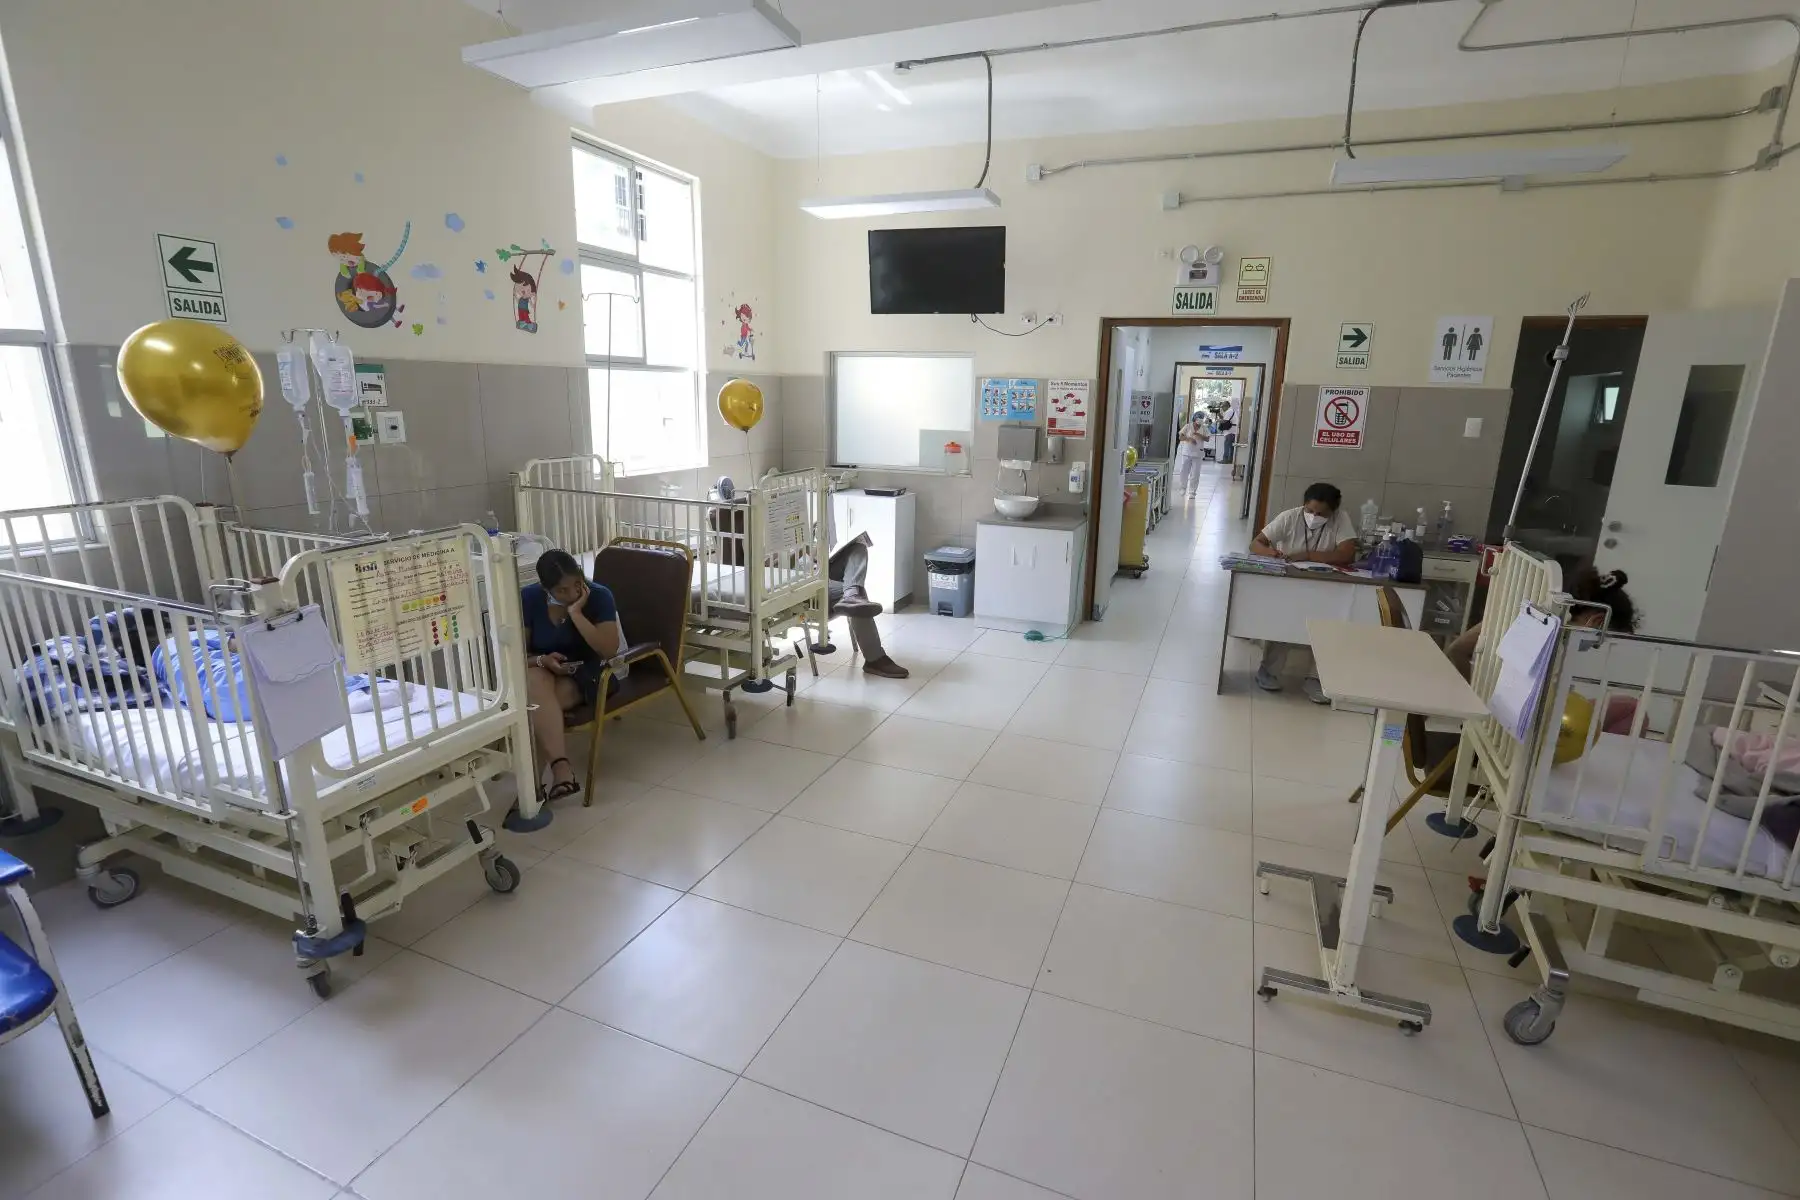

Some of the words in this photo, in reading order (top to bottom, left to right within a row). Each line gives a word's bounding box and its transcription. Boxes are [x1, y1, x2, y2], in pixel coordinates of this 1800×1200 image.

[1175, 292, 1213, 309] SALIDA
[173, 297, 222, 315] SALIDA
[1338, 357, 1366, 366] SALIDA
[1319, 436, 1357, 444] CELULARES
[421, 549, 450, 559] MEDICINA
